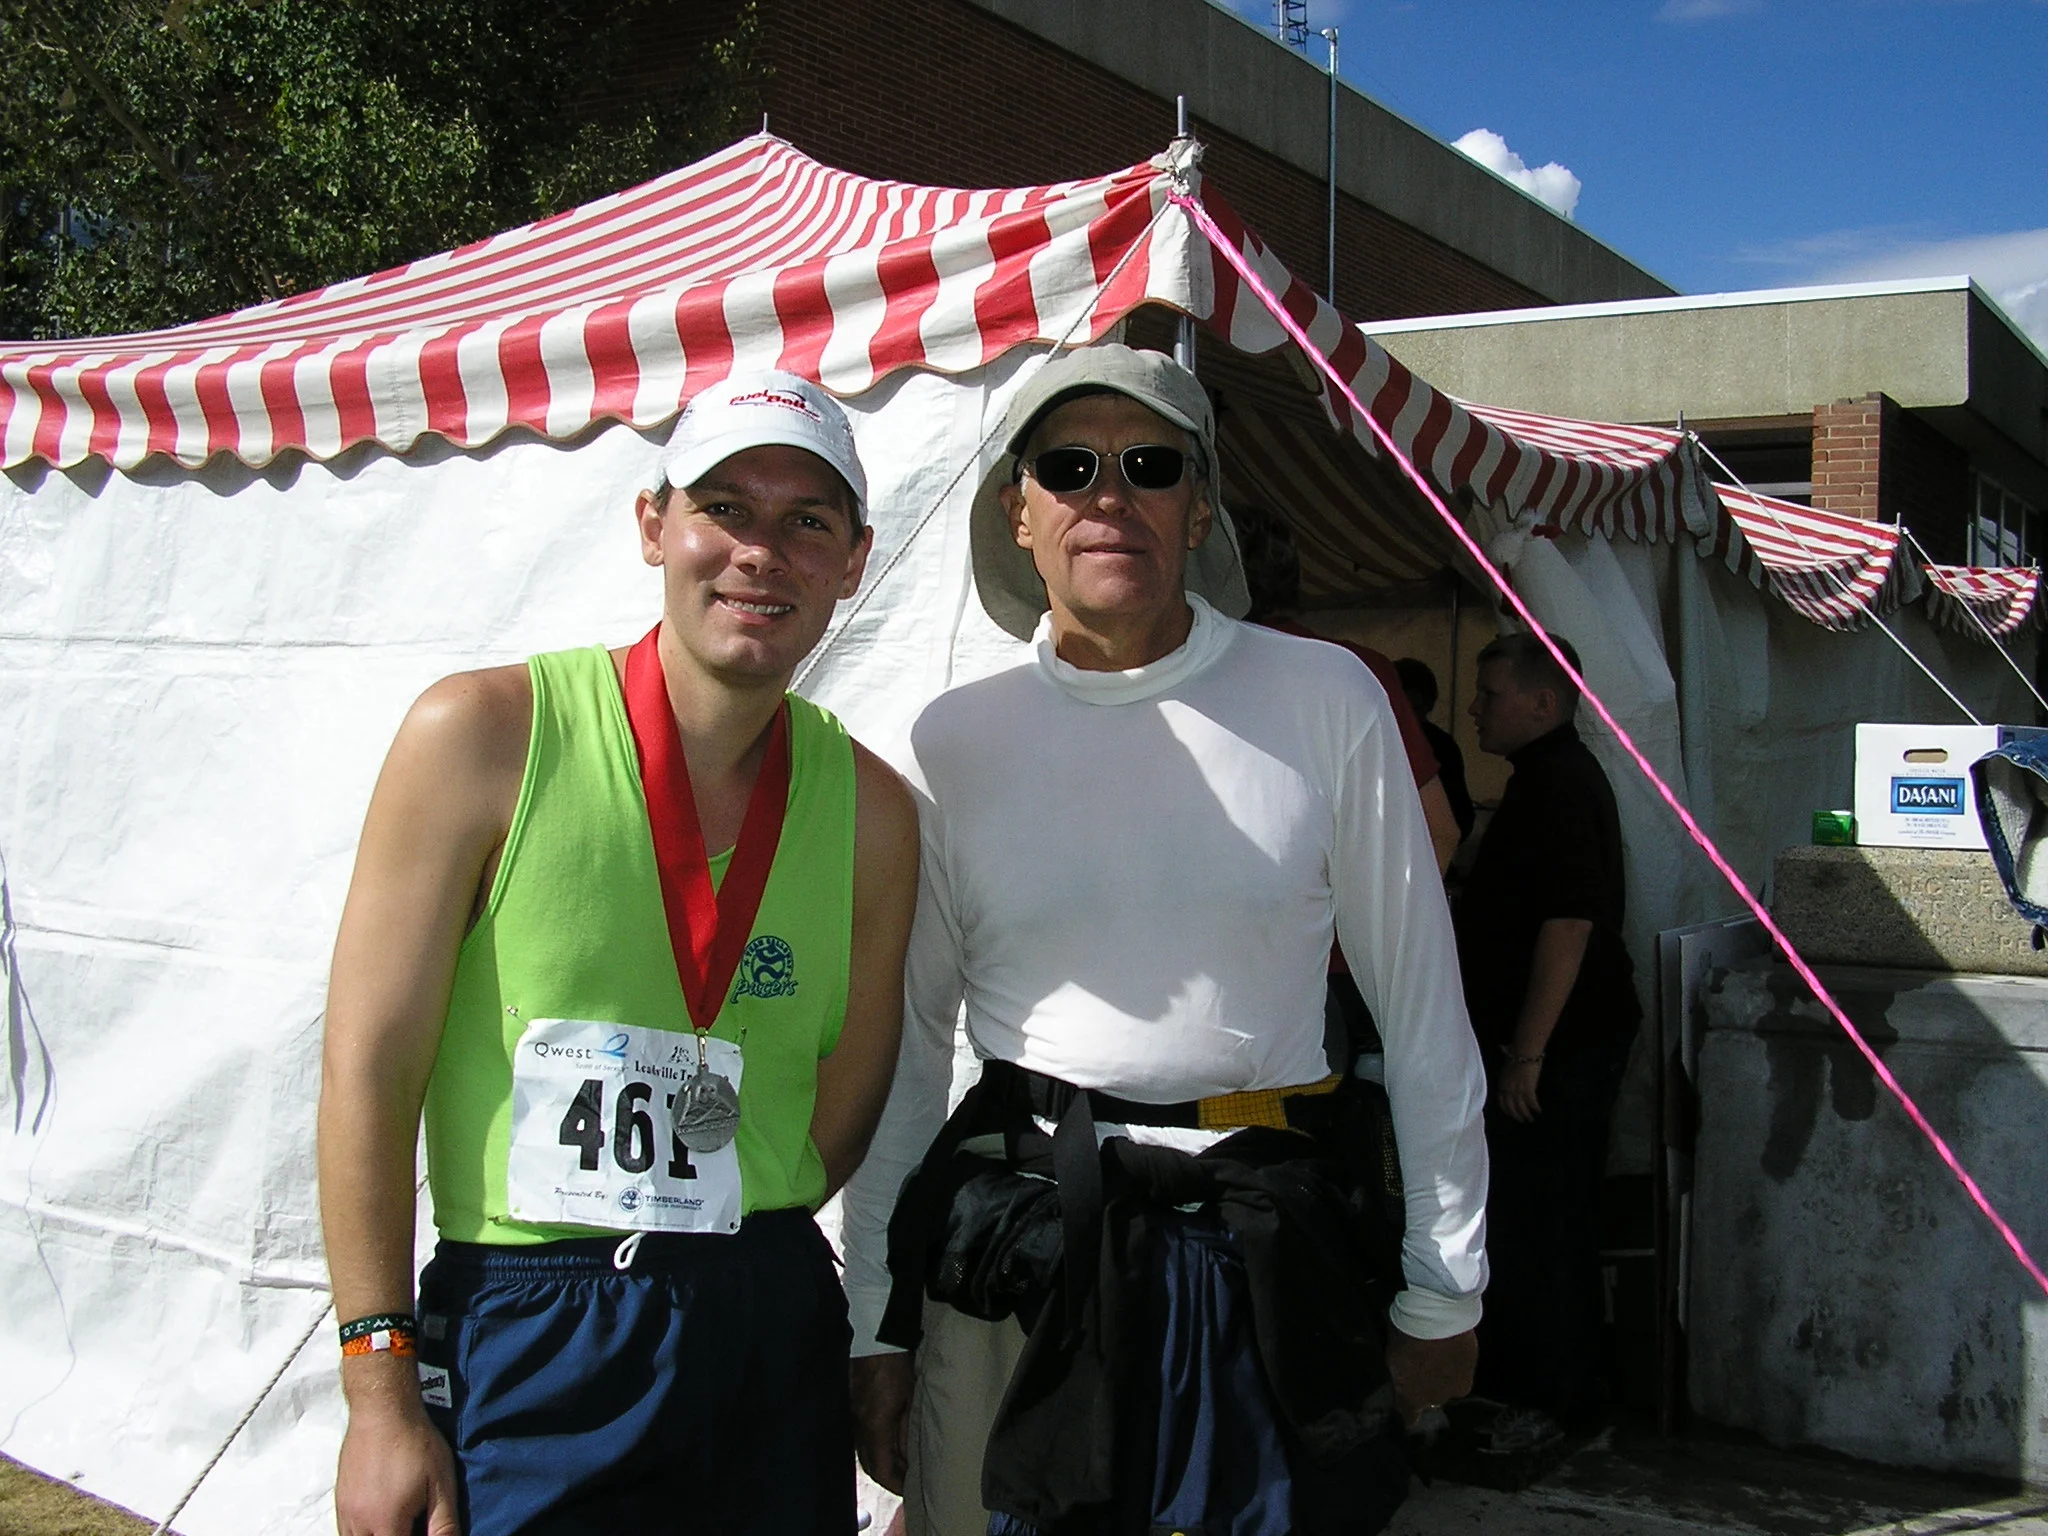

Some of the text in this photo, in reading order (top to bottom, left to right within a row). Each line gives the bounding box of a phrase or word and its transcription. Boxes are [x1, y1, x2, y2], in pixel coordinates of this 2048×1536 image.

[766, 395, 806, 410] Belt
[1899, 786, 1956, 805] DASANI
[534, 1041, 593, 1059] Qwest
[559, 1079, 698, 1179] 461
[645, 1195, 702, 1207] TIMBERLAND
